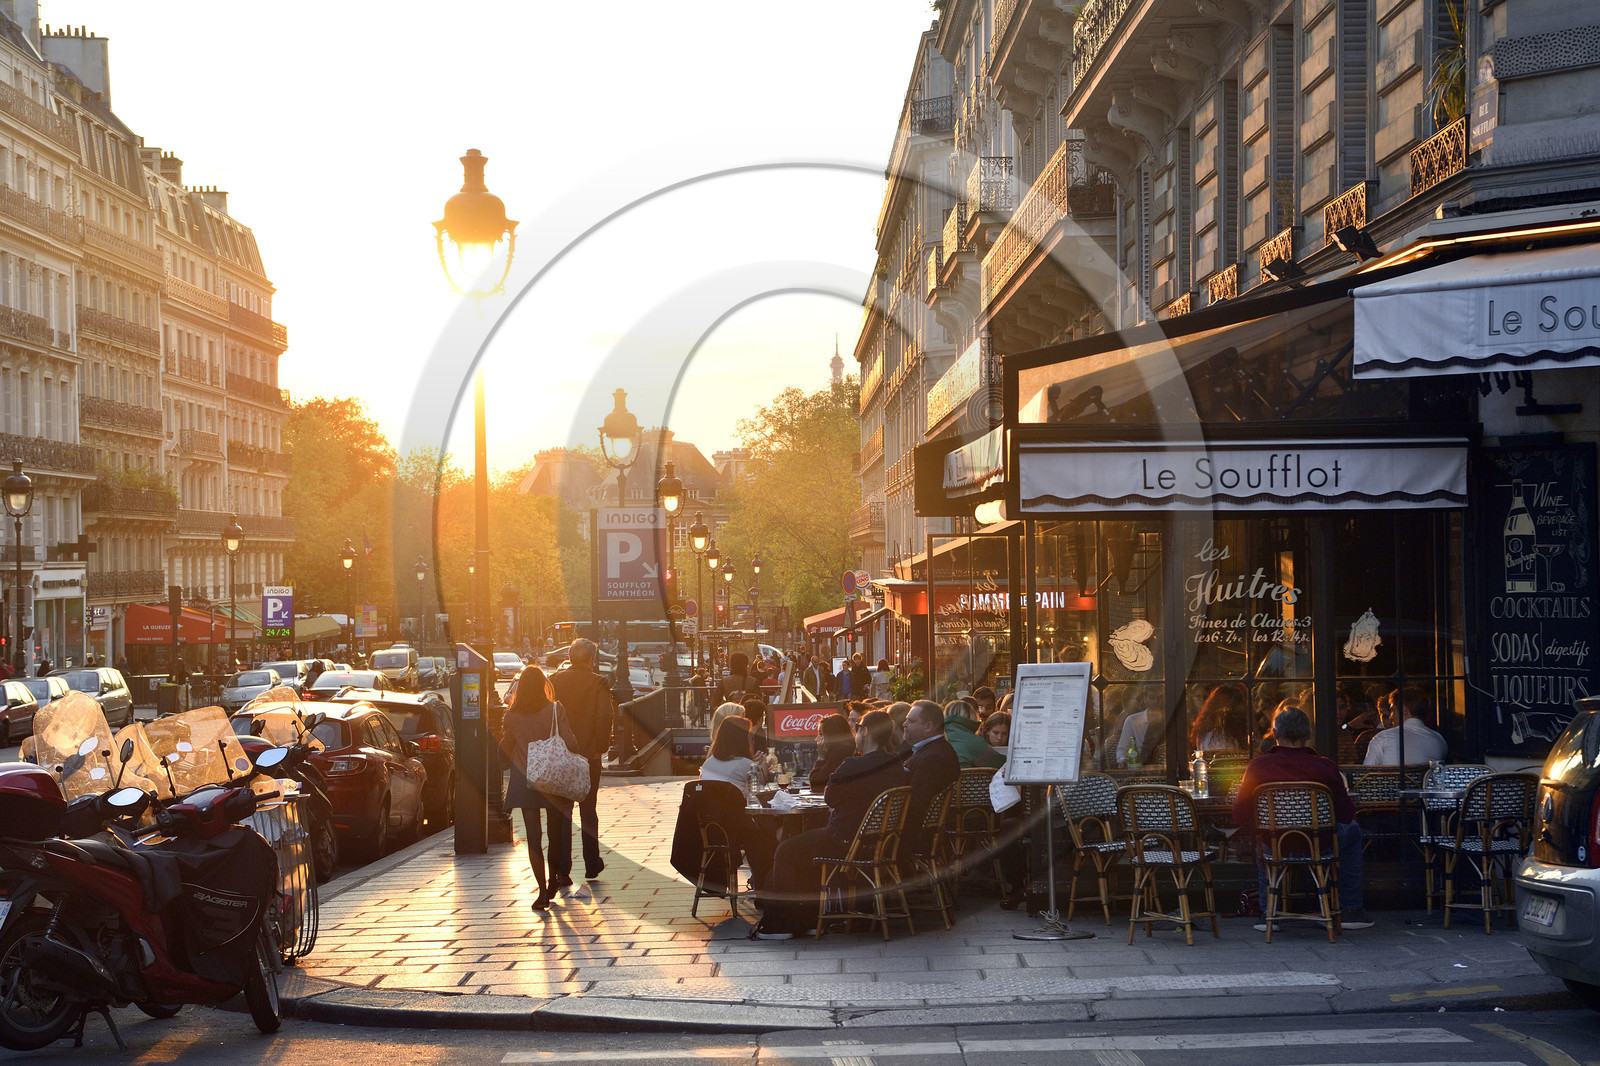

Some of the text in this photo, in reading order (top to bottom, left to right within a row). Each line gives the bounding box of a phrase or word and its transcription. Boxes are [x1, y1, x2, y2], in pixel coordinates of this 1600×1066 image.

[1472, 117, 1496, 138] SOUFFLOT
[1488, 300, 1522, 336] Le
[1142, 454, 1342, 490] Le Soufflot
[606, 513, 658, 524] INDIGO
[606, 532, 642, 578] P
[1194, 538, 1231, 562] les
[267, 598, 283, 618] P
[1036, 591, 1065, 608] PAIN
[1490, 596, 1591, 618] COCKTAILS
[1230, 612, 1246, 628] de
[1490, 632, 1540, 664] SODAS
[1544, 638, 1591, 666] digestifs
[1492, 674, 1590, 710] LIQUEURS
[192, 892, 248, 908] BAGSTER
